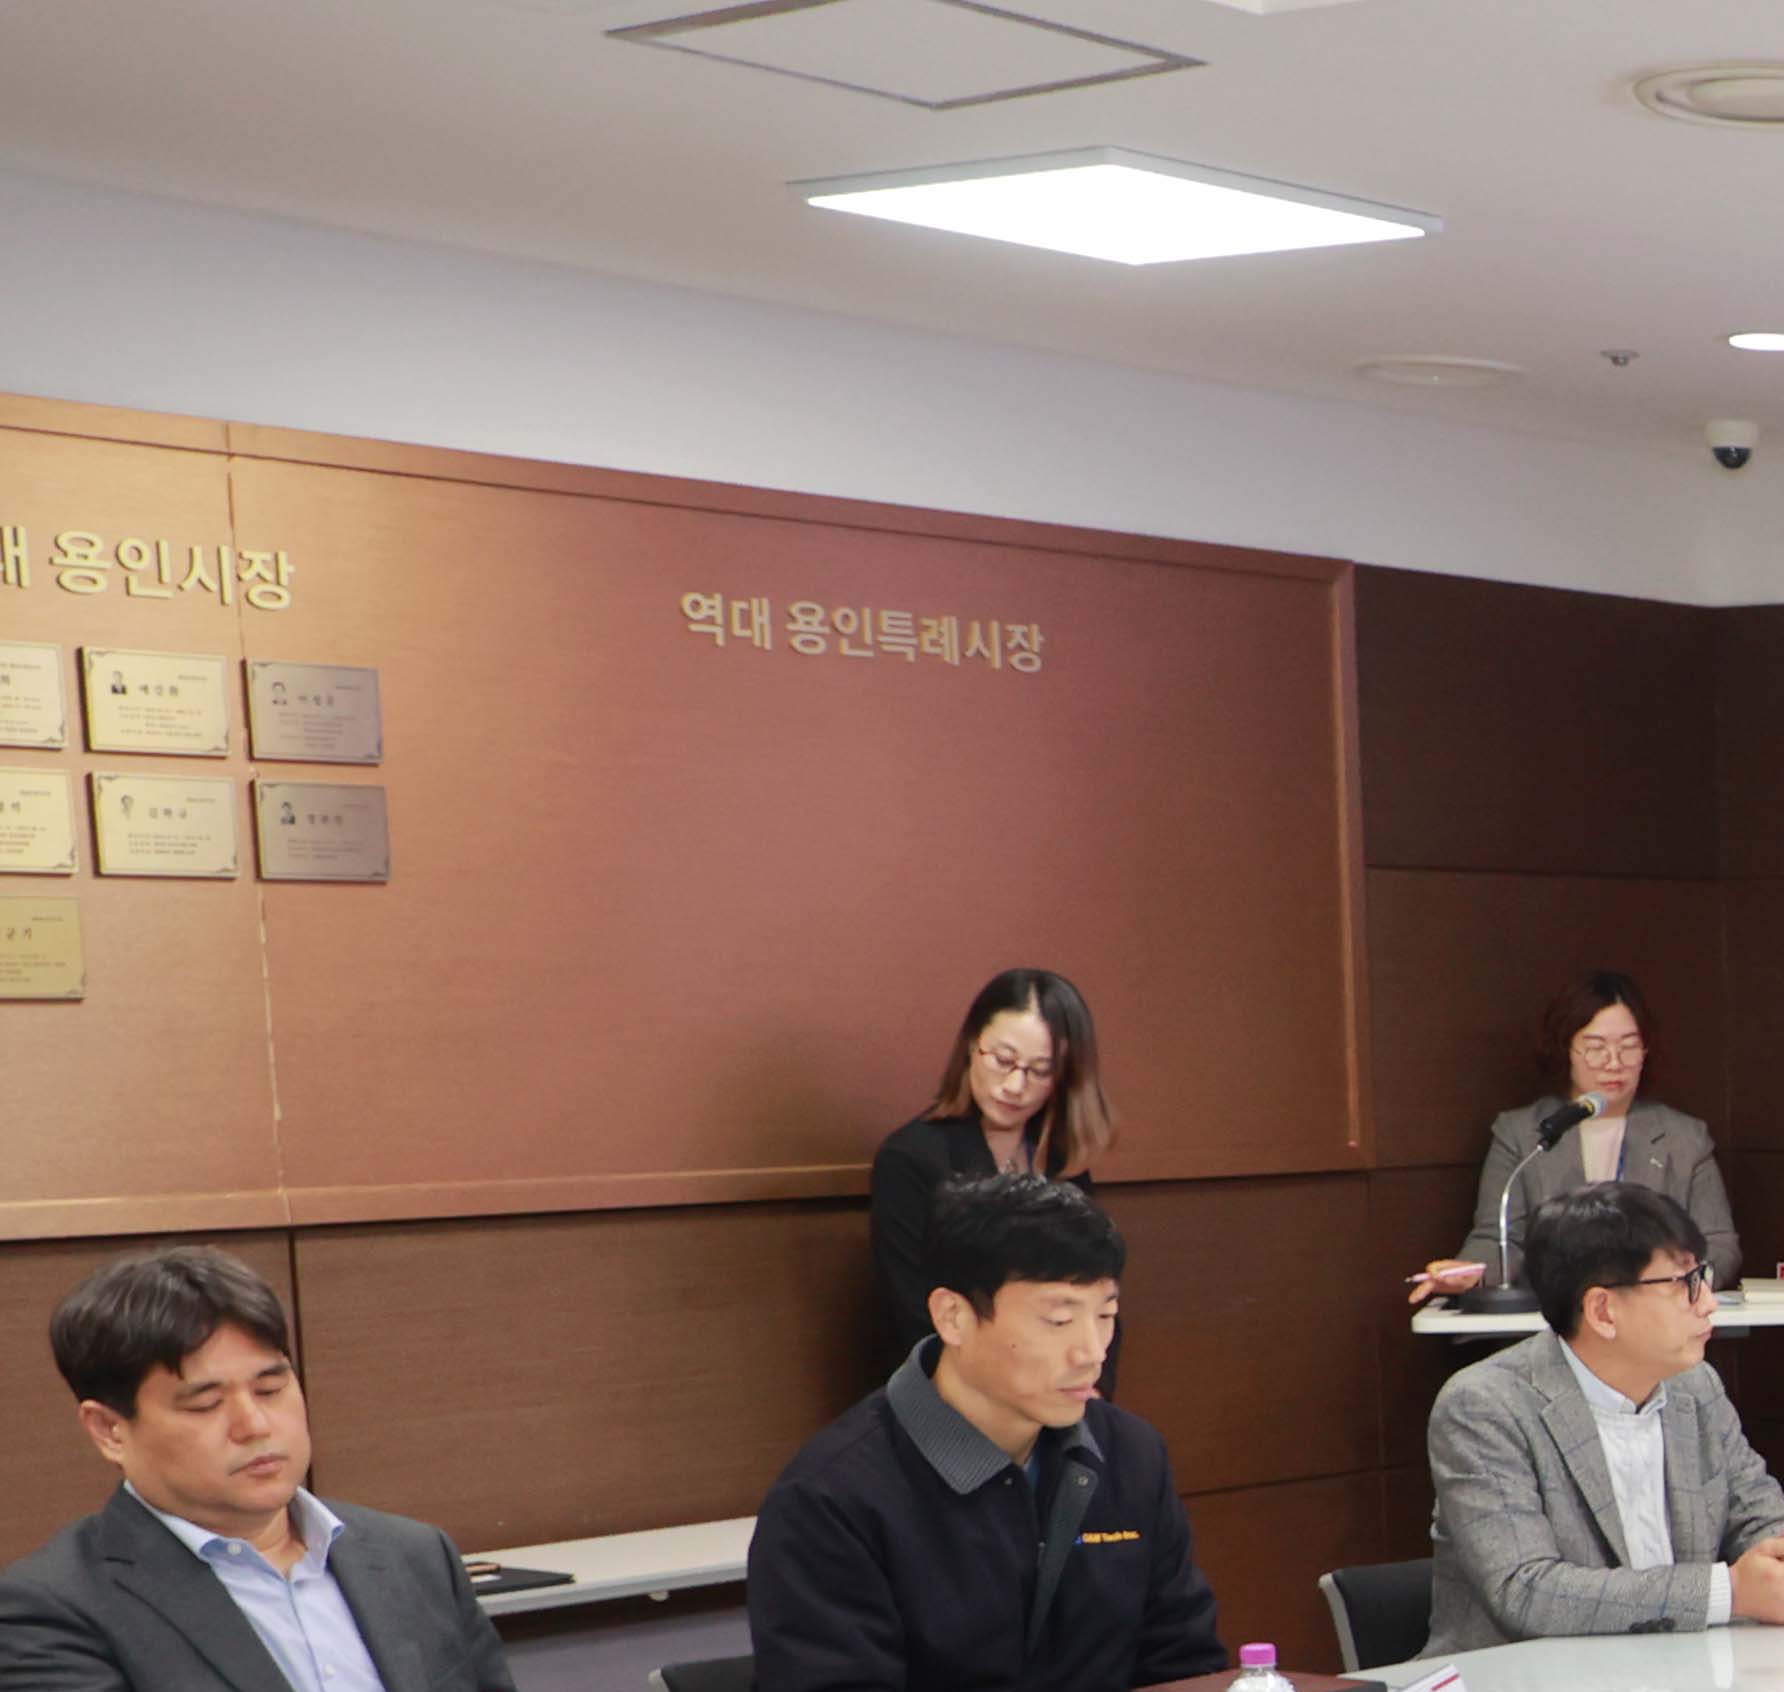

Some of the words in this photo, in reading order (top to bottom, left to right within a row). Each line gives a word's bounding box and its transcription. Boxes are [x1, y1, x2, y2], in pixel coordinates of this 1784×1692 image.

[48, 530, 297, 611] 용인시장
[680, 591, 773, 650] 역대
[785, 600, 1044, 673] 용인특례시장
